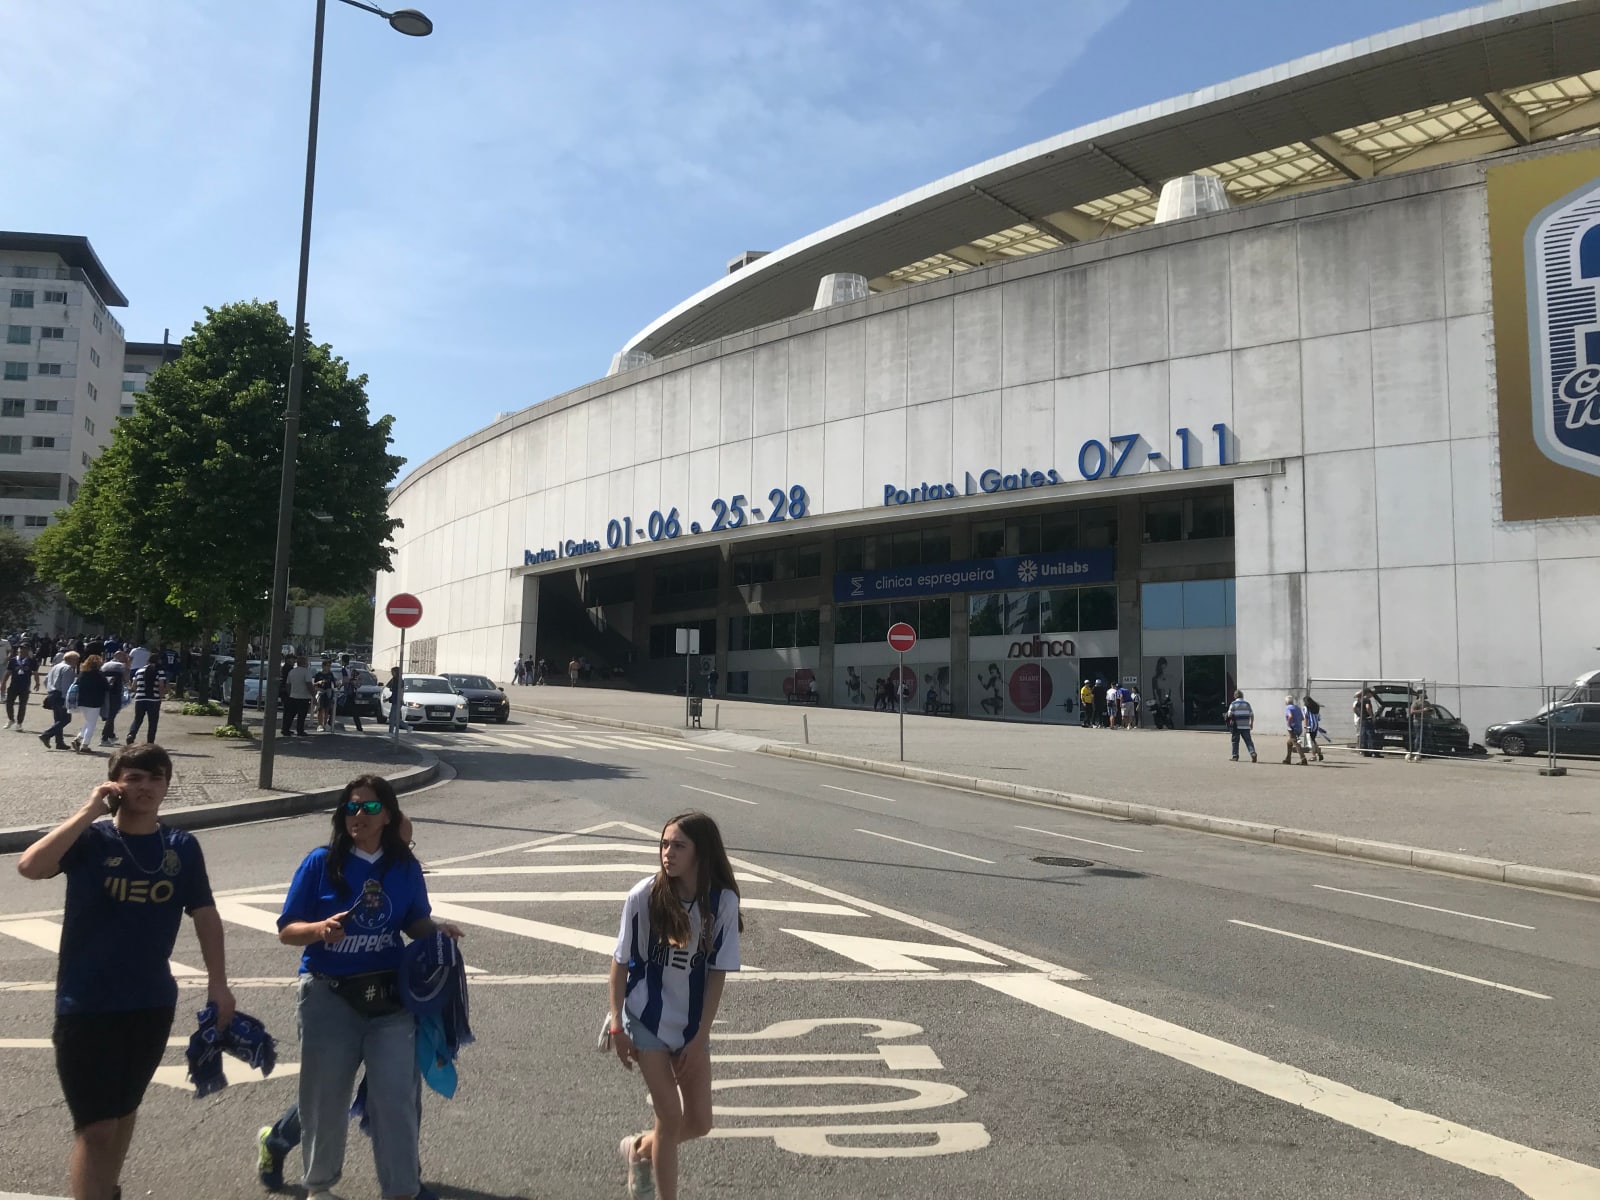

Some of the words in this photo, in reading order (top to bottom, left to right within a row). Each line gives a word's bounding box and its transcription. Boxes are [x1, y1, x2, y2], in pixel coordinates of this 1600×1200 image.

[883, 481, 955, 506] Portas
[979, 468, 1057, 494] Gates
[524, 548, 557, 566] Portas
[565, 538, 601, 558] Gates
[917, 567, 995, 588] espregueira
[1040, 561, 1089, 576] Unilabs
[103, 877, 175, 904] MEO
[645, 1017, 992, 1159] STOP
